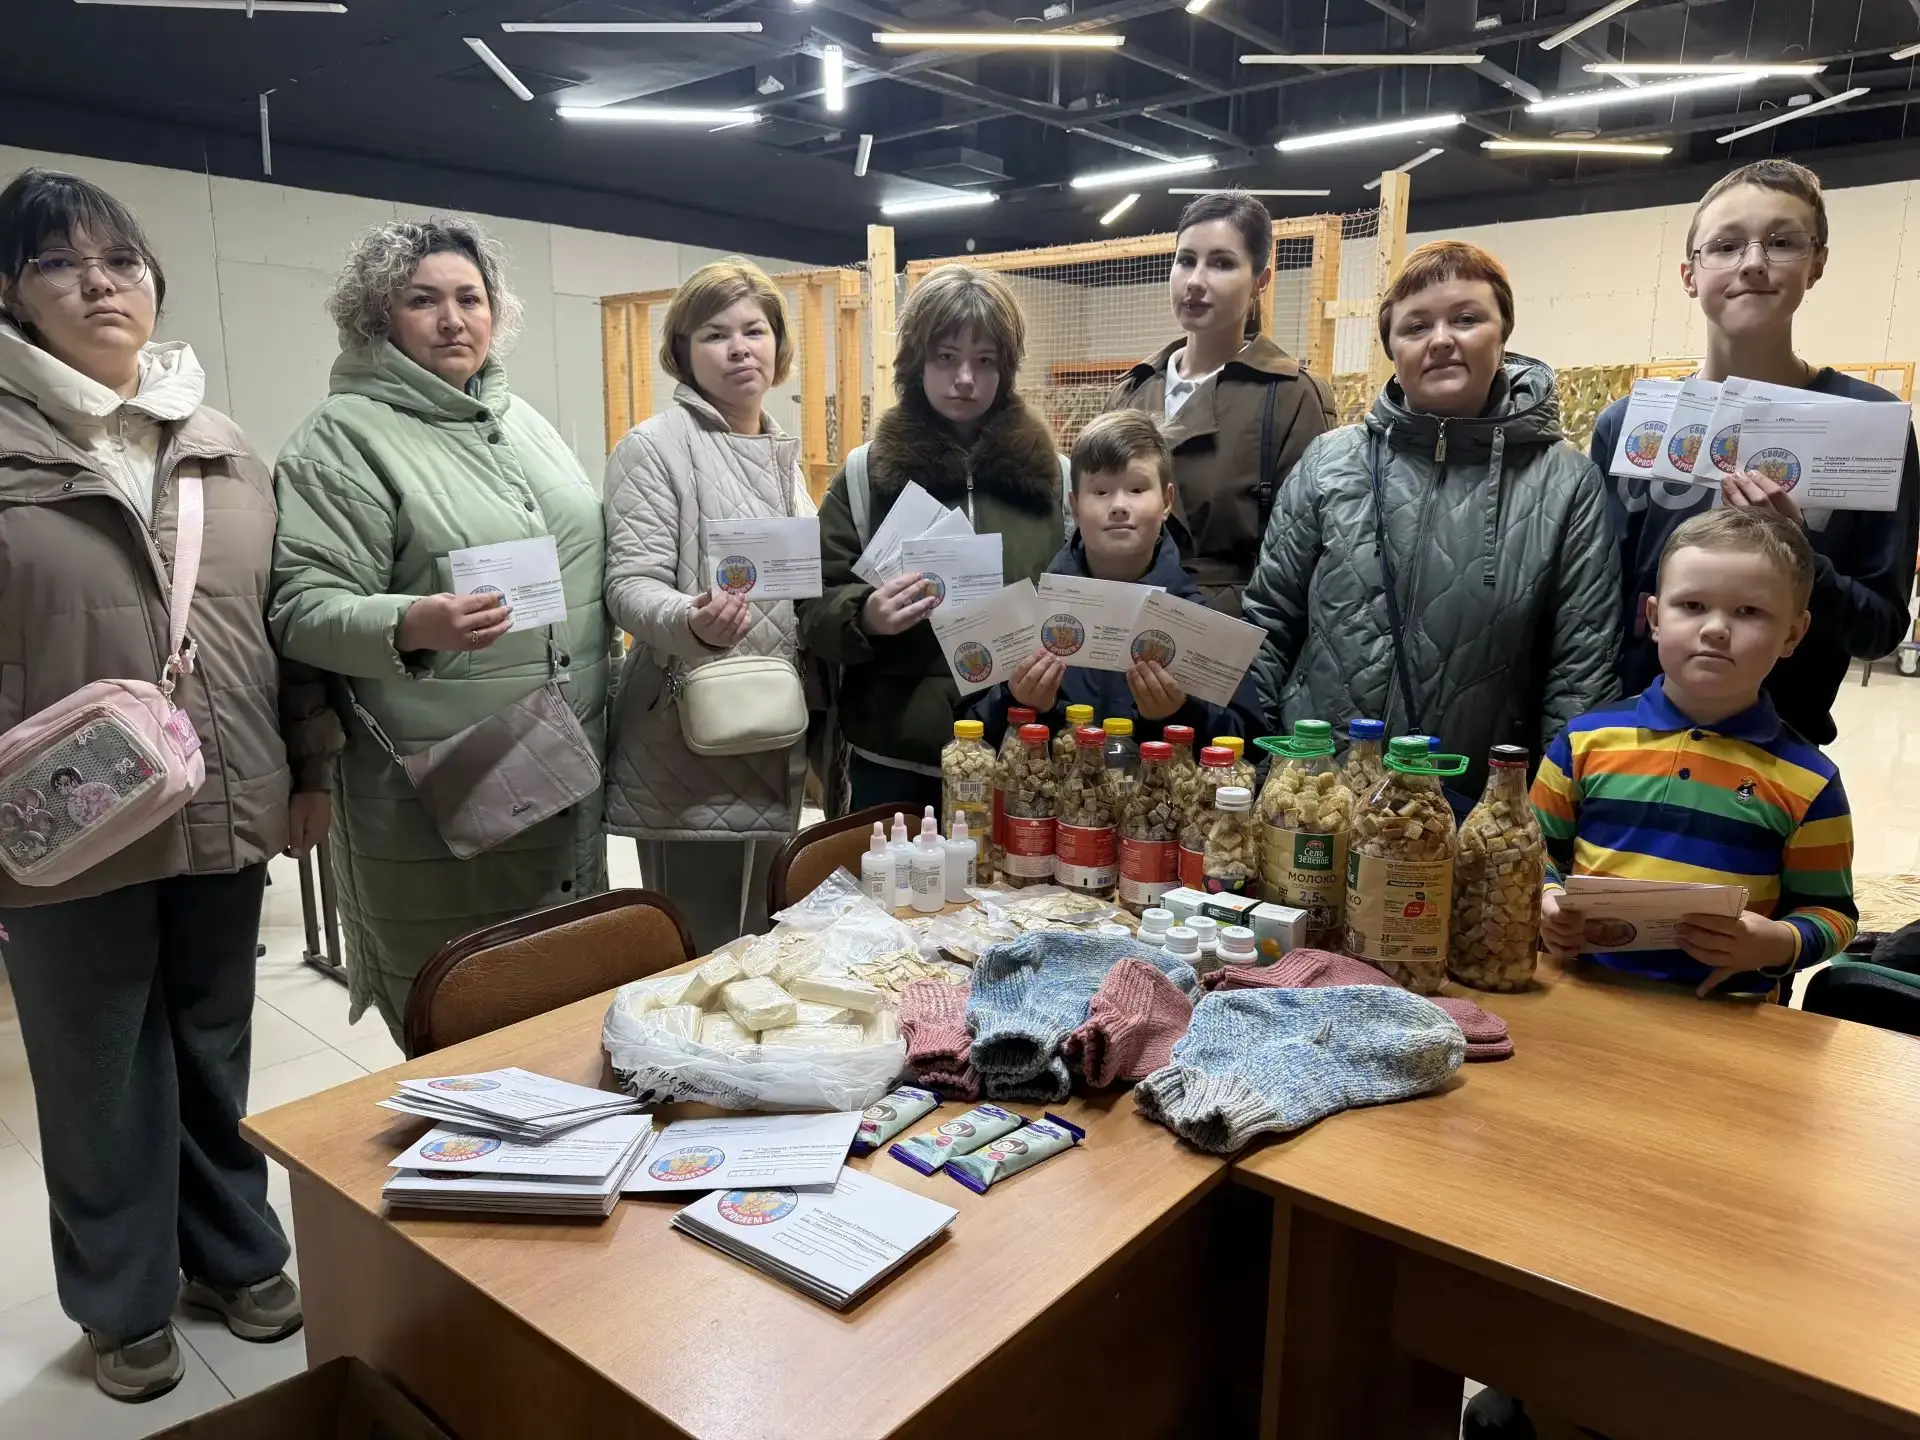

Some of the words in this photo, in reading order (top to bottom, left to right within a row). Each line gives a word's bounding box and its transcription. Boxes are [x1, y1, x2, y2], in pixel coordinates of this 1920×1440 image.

[1644, 422, 1668, 434] СВОИ
[1689, 425, 1708, 436] СВО
[1761, 450, 1790, 460] СВОИХ
[1633, 458, 1654, 468] БРОСА
[1675, 460, 1693, 472] БРОС
[1718, 461, 1736, 473] БРОС
[1304, 847, 1325, 858] Село
[1288, 871, 1337, 884] МОЛОКО
[679, 1147, 715, 1155] СВОИХ
[721, 1207, 763, 1225] БРОСАЕМ
